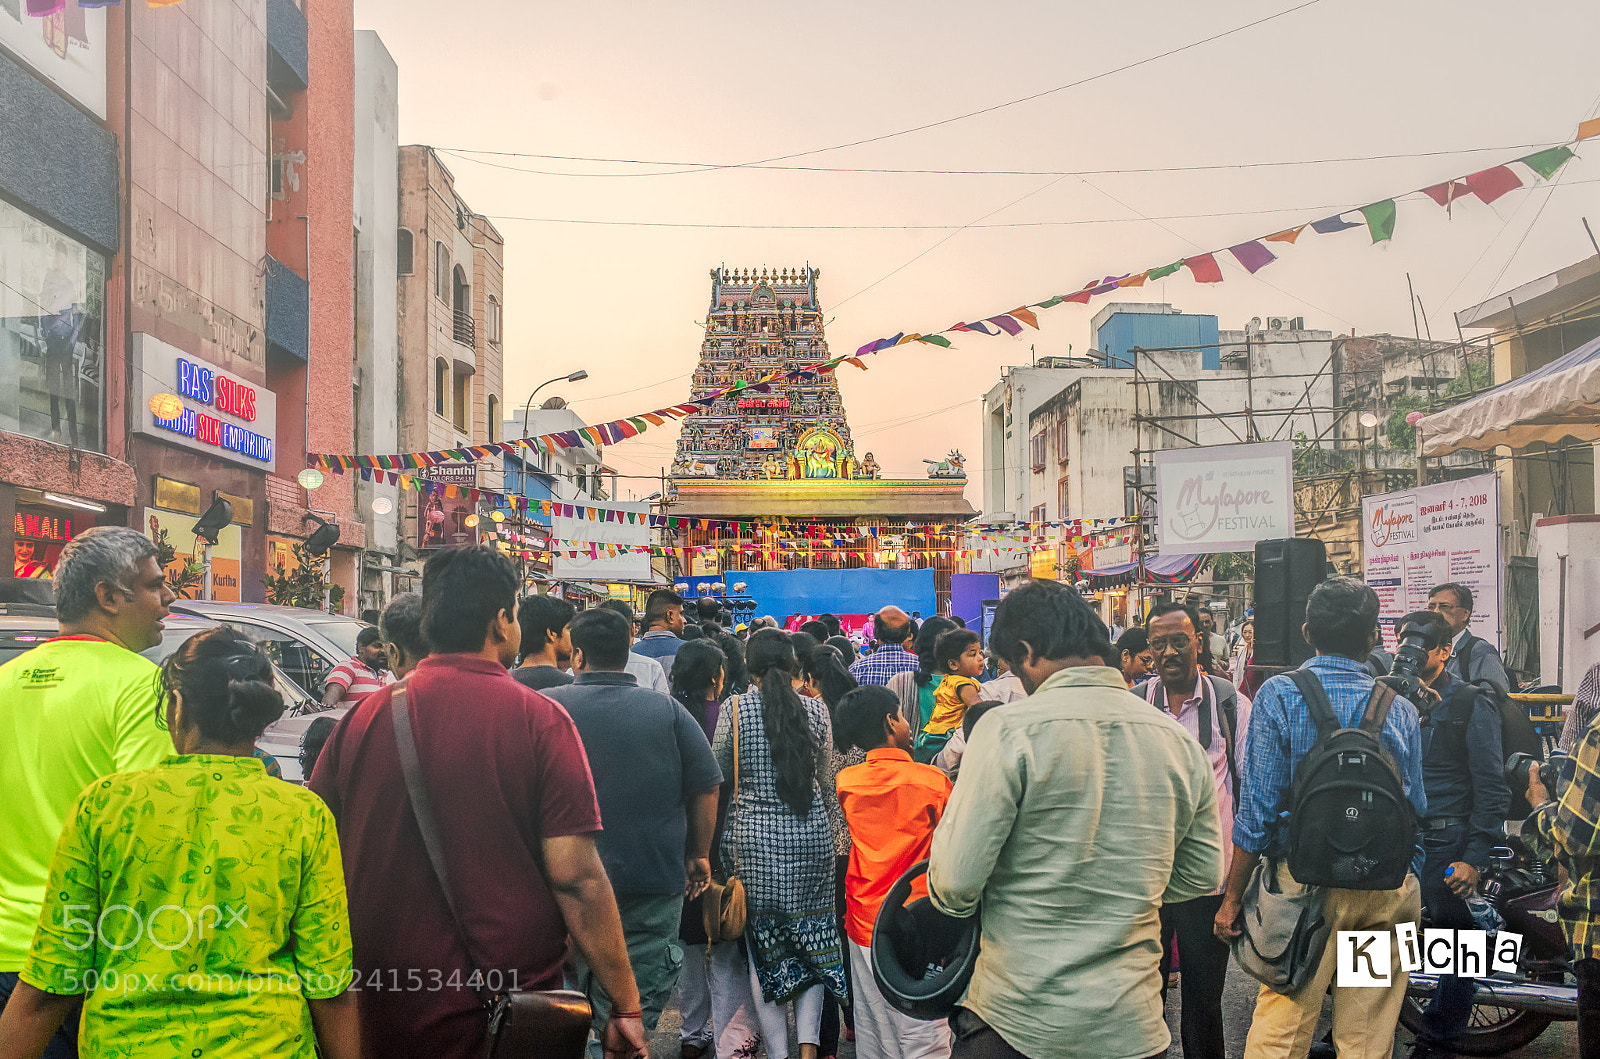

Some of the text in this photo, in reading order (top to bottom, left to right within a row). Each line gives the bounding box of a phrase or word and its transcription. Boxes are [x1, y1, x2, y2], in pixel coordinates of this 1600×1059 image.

[217, 375, 256, 422] SILKS
[197, 412, 221, 446] SILK
[221, 422, 272, 462] EMPORIUM
[430, 465, 475, 476] Shanthi
[1172, 475, 1275, 529] Mylapore
[1448, 499, 1453, 510] 4
[1469, 493, 1488, 507] 2018
[1217, 515, 1275, 530] FESTIVAL
[1371, 507, 1415, 538] Mylapore
[1389, 530, 1415, 540] FESTIVAL
[213, 573, 237, 587] Kurtha
